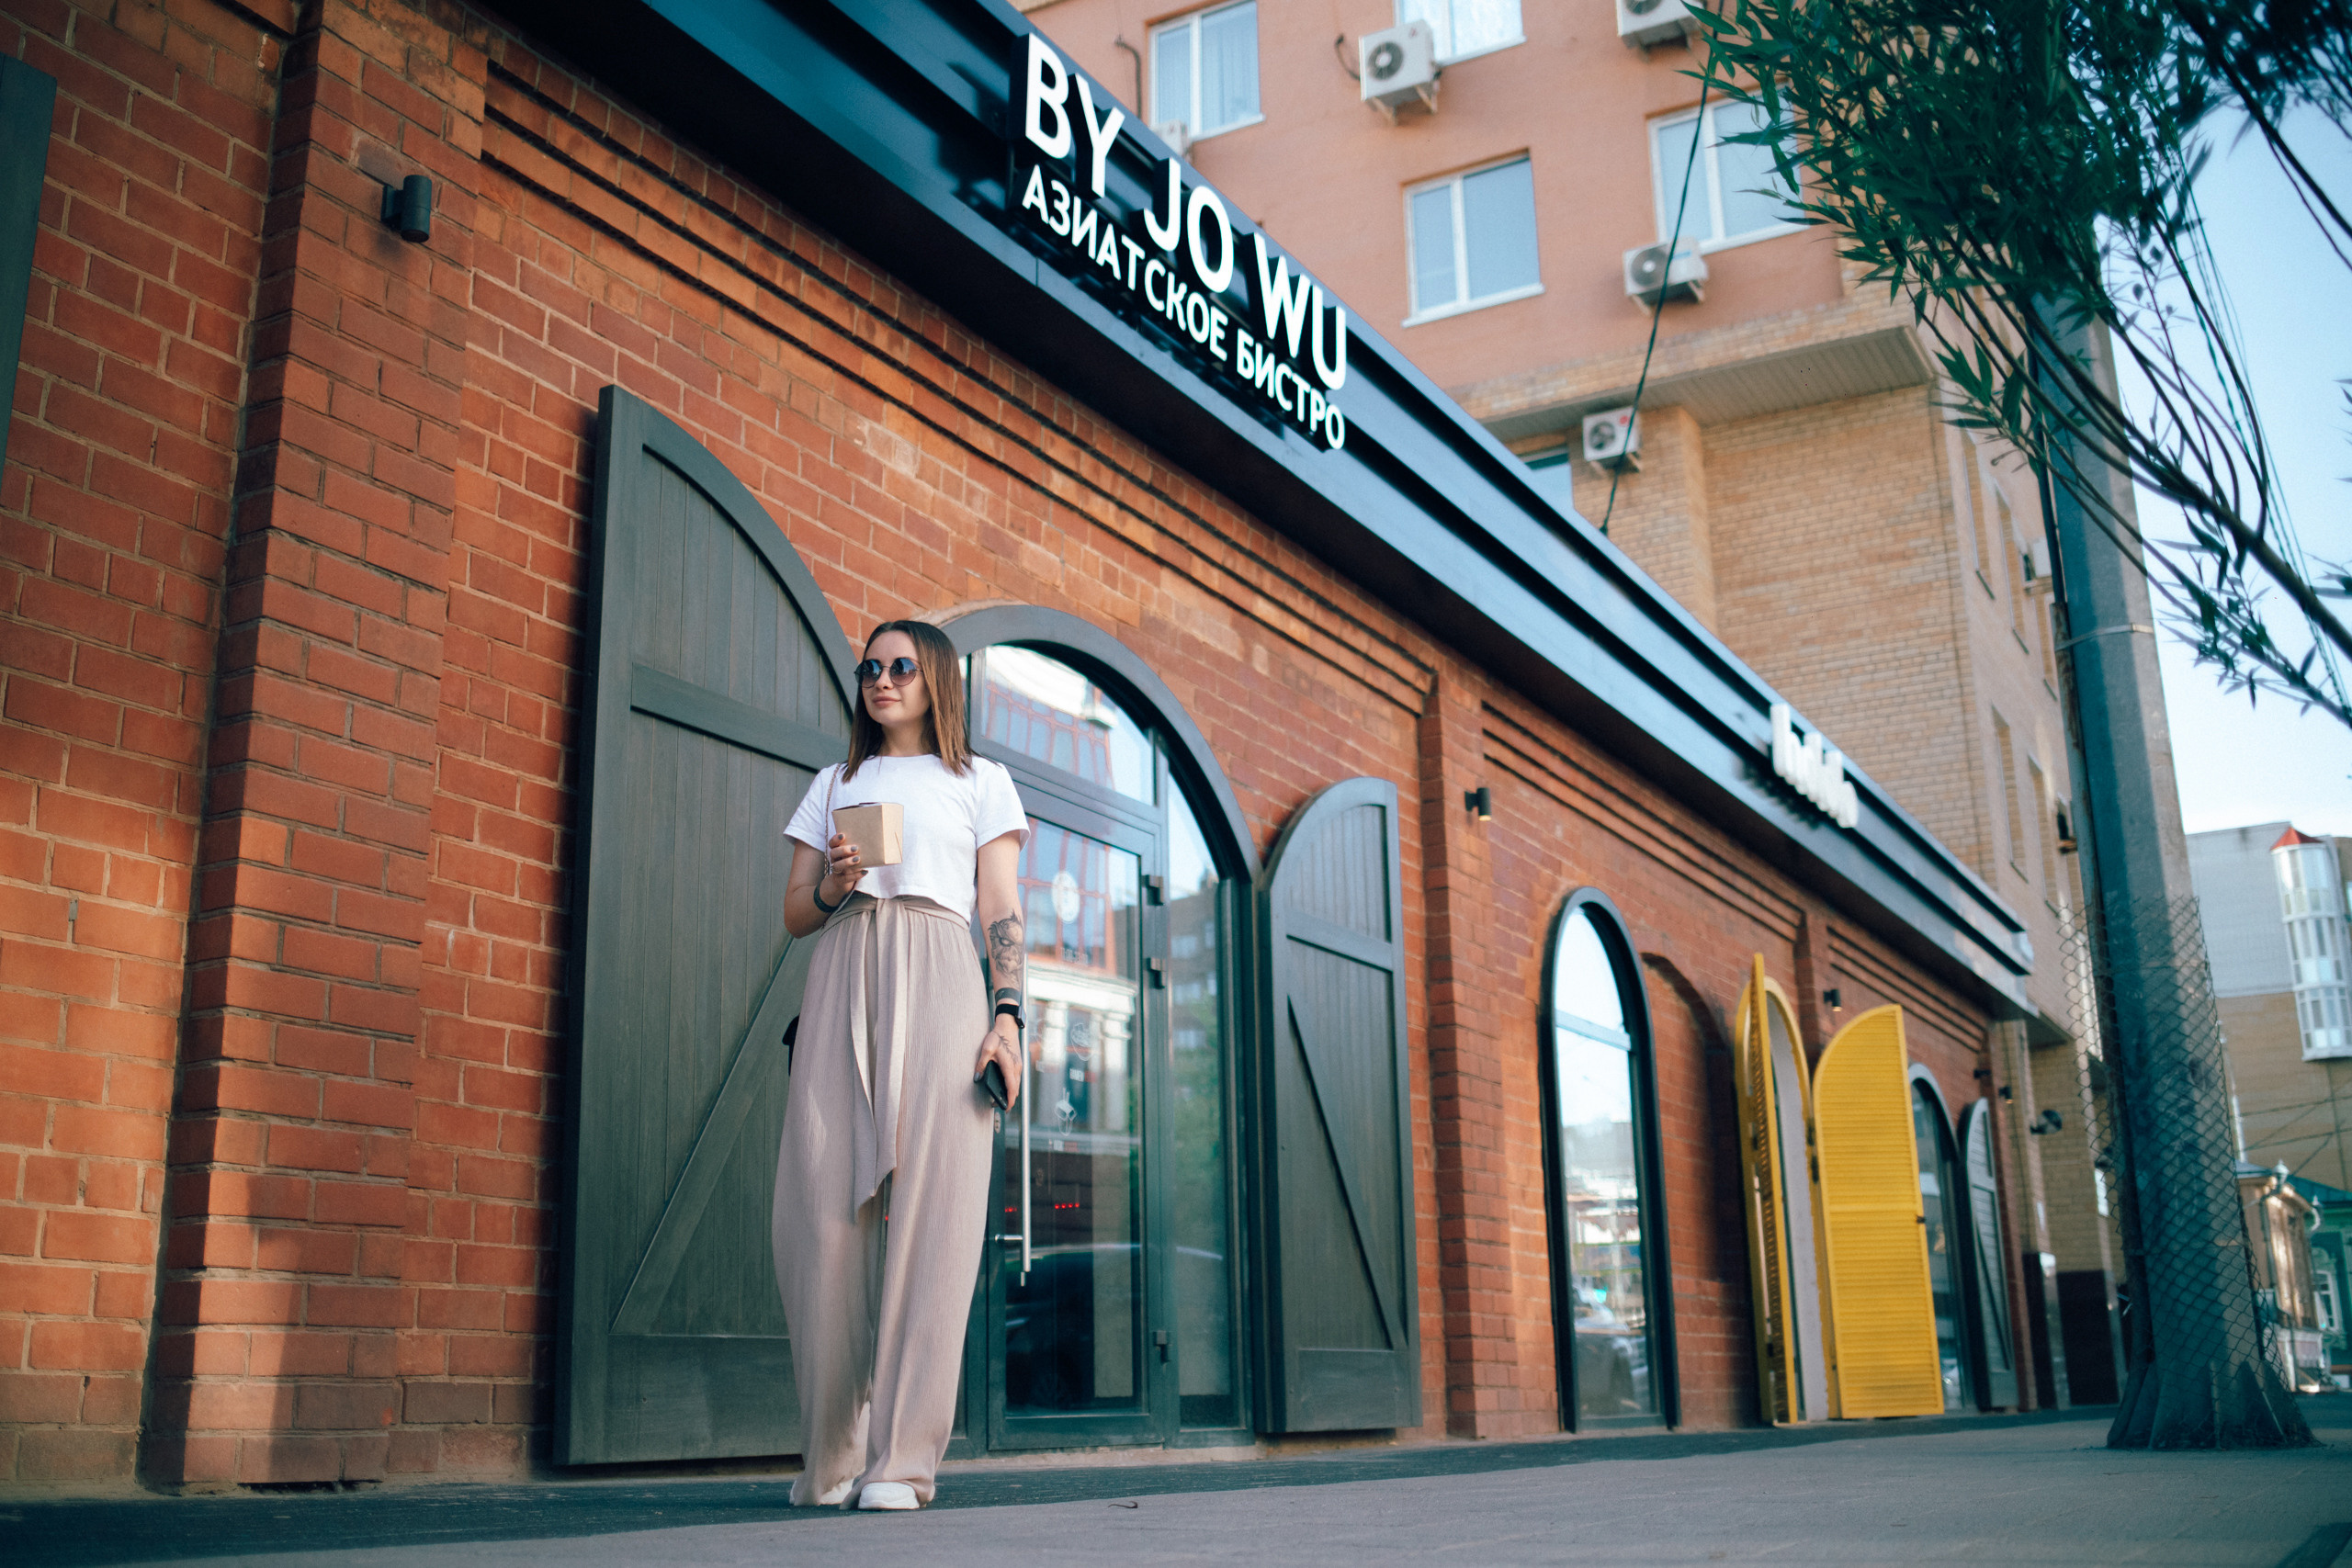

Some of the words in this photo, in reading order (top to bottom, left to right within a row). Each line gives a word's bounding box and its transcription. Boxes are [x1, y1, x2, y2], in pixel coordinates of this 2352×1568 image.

[1022, 164, 1228, 362] АЗИАТСКОЕ
[1237, 328, 1345, 450] БИСТРО
[1025, 33, 1125, 198] BY
[1143, 157, 1235, 294] JO
[1253, 231, 1347, 390] WU
